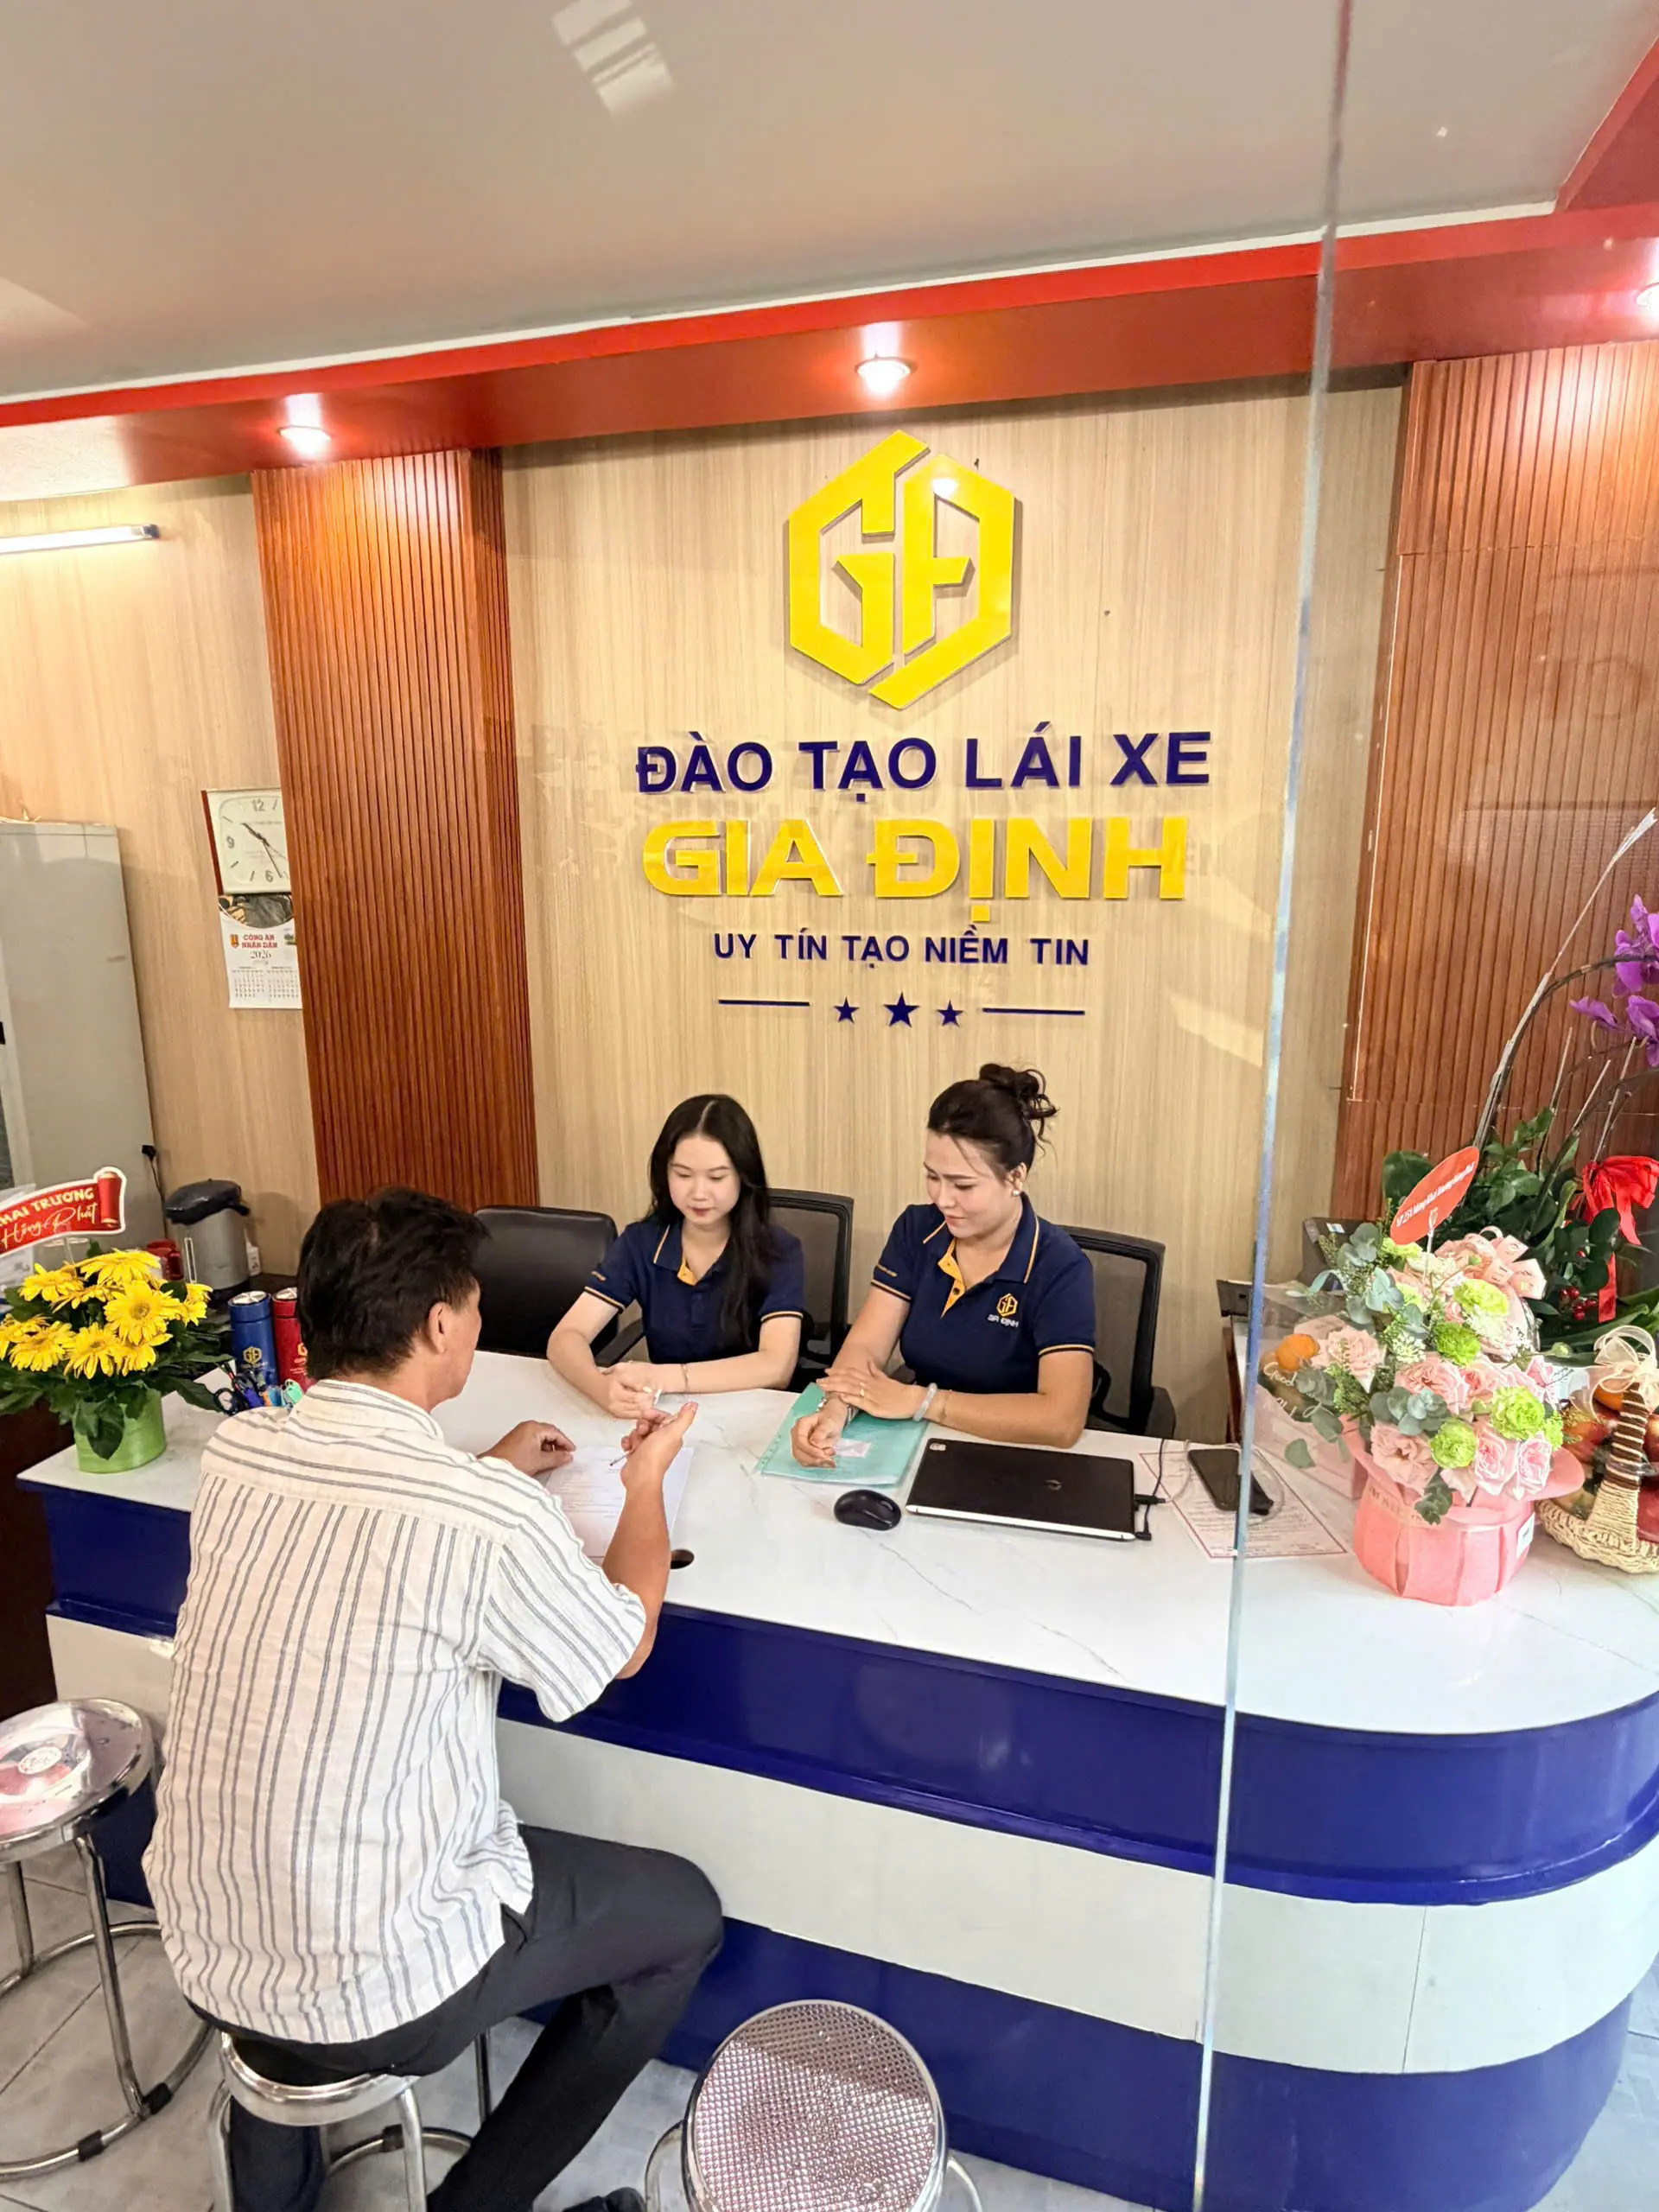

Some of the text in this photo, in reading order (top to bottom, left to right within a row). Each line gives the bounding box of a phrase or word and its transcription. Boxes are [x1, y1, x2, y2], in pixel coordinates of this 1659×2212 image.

[636, 721, 1211, 803] ĐÀO TẠO LÁI XE
[643, 817, 1188, 921] GIA ĐỊNH
[714, 925, 1089, 968] UY TÍN TẠO NIỀM TIN
